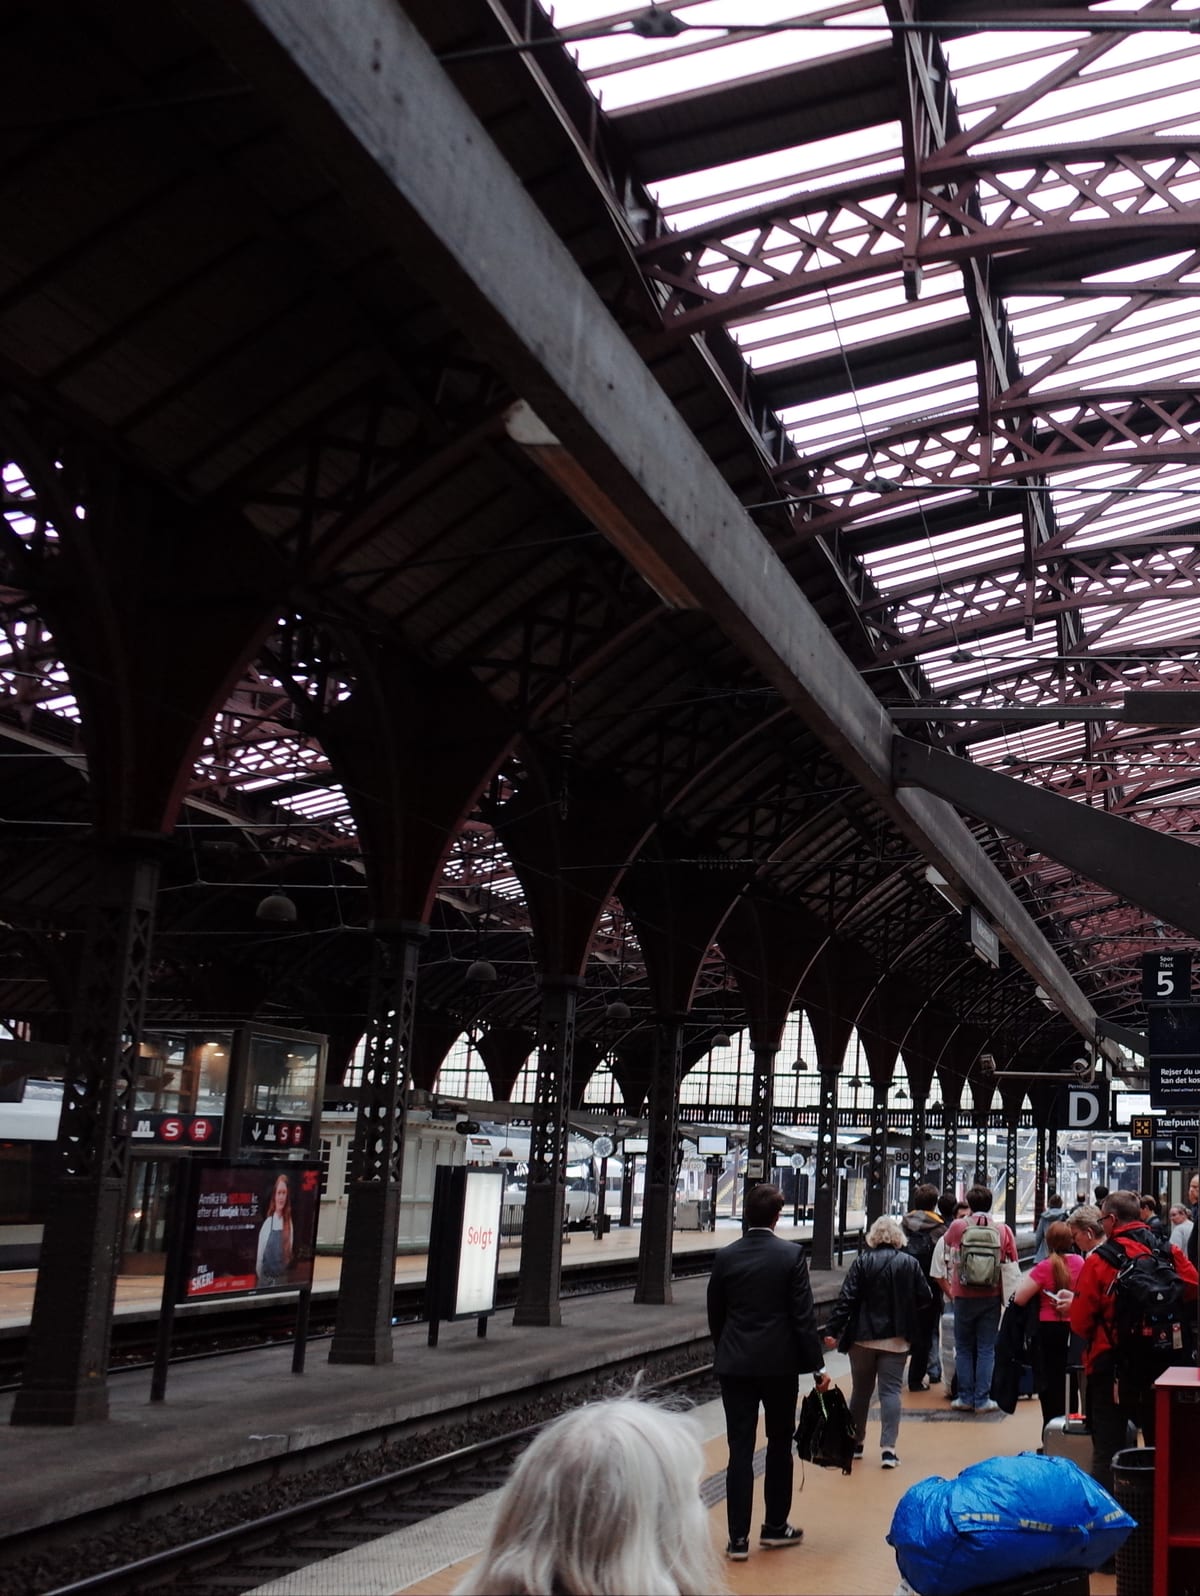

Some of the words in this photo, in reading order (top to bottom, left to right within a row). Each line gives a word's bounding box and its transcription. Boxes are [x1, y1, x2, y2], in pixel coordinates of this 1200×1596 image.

[1157, 971, 1174, 996] 5
[1160, 1068, 1182, 1076] Rejser
[1068, 1091, 1100, 1127] D
[165, 1121, 179, 1137] S
[1156, 1117, 1200, 1128] Træfpunkt
[281, 1126, 288, 1140] S
[895, 1152, 909, 1162] 80
[927, 1152, 941, 1162] 80
[467, 1226, 493, 1250] Solgt
